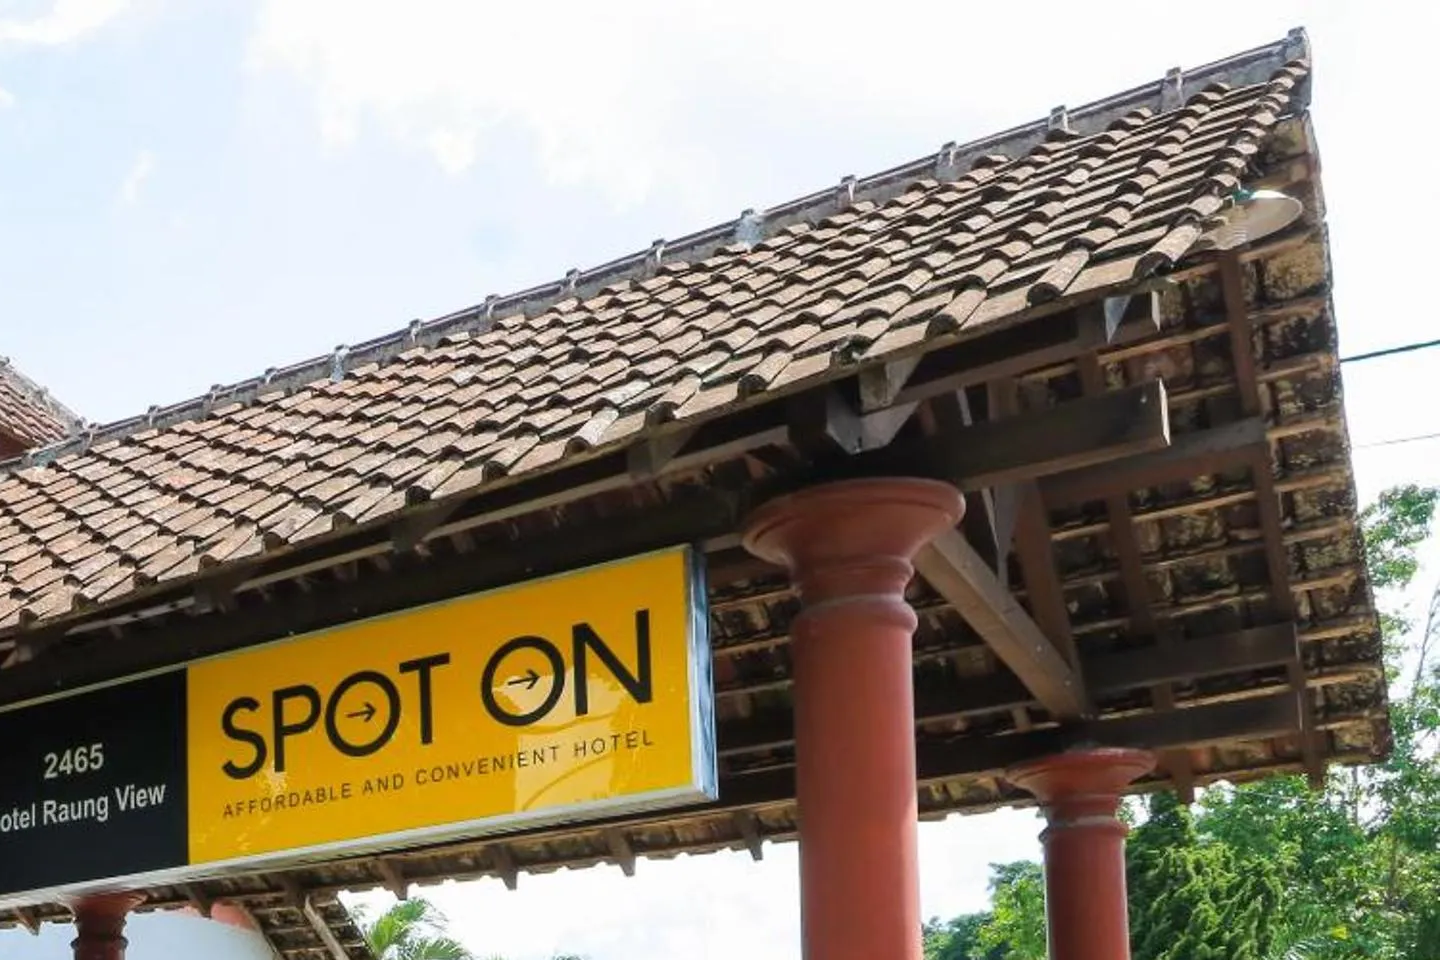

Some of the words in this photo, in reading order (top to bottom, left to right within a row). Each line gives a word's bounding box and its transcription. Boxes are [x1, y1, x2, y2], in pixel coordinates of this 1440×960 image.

[221, 652, 450, 781] SPOT
[480, 608, 653, 727] ON
[43, 743, 105, 779] 2465
[222, 783, 353, 819] AFFORDABLE
[362, 773, 405, 795] AND
[415, 745, 560, 786] CONVENIENT
[573, 729, 654, 758] HOTEL
[42, 795, 109, 822] Raung
[115, 783, 167, 811] View
